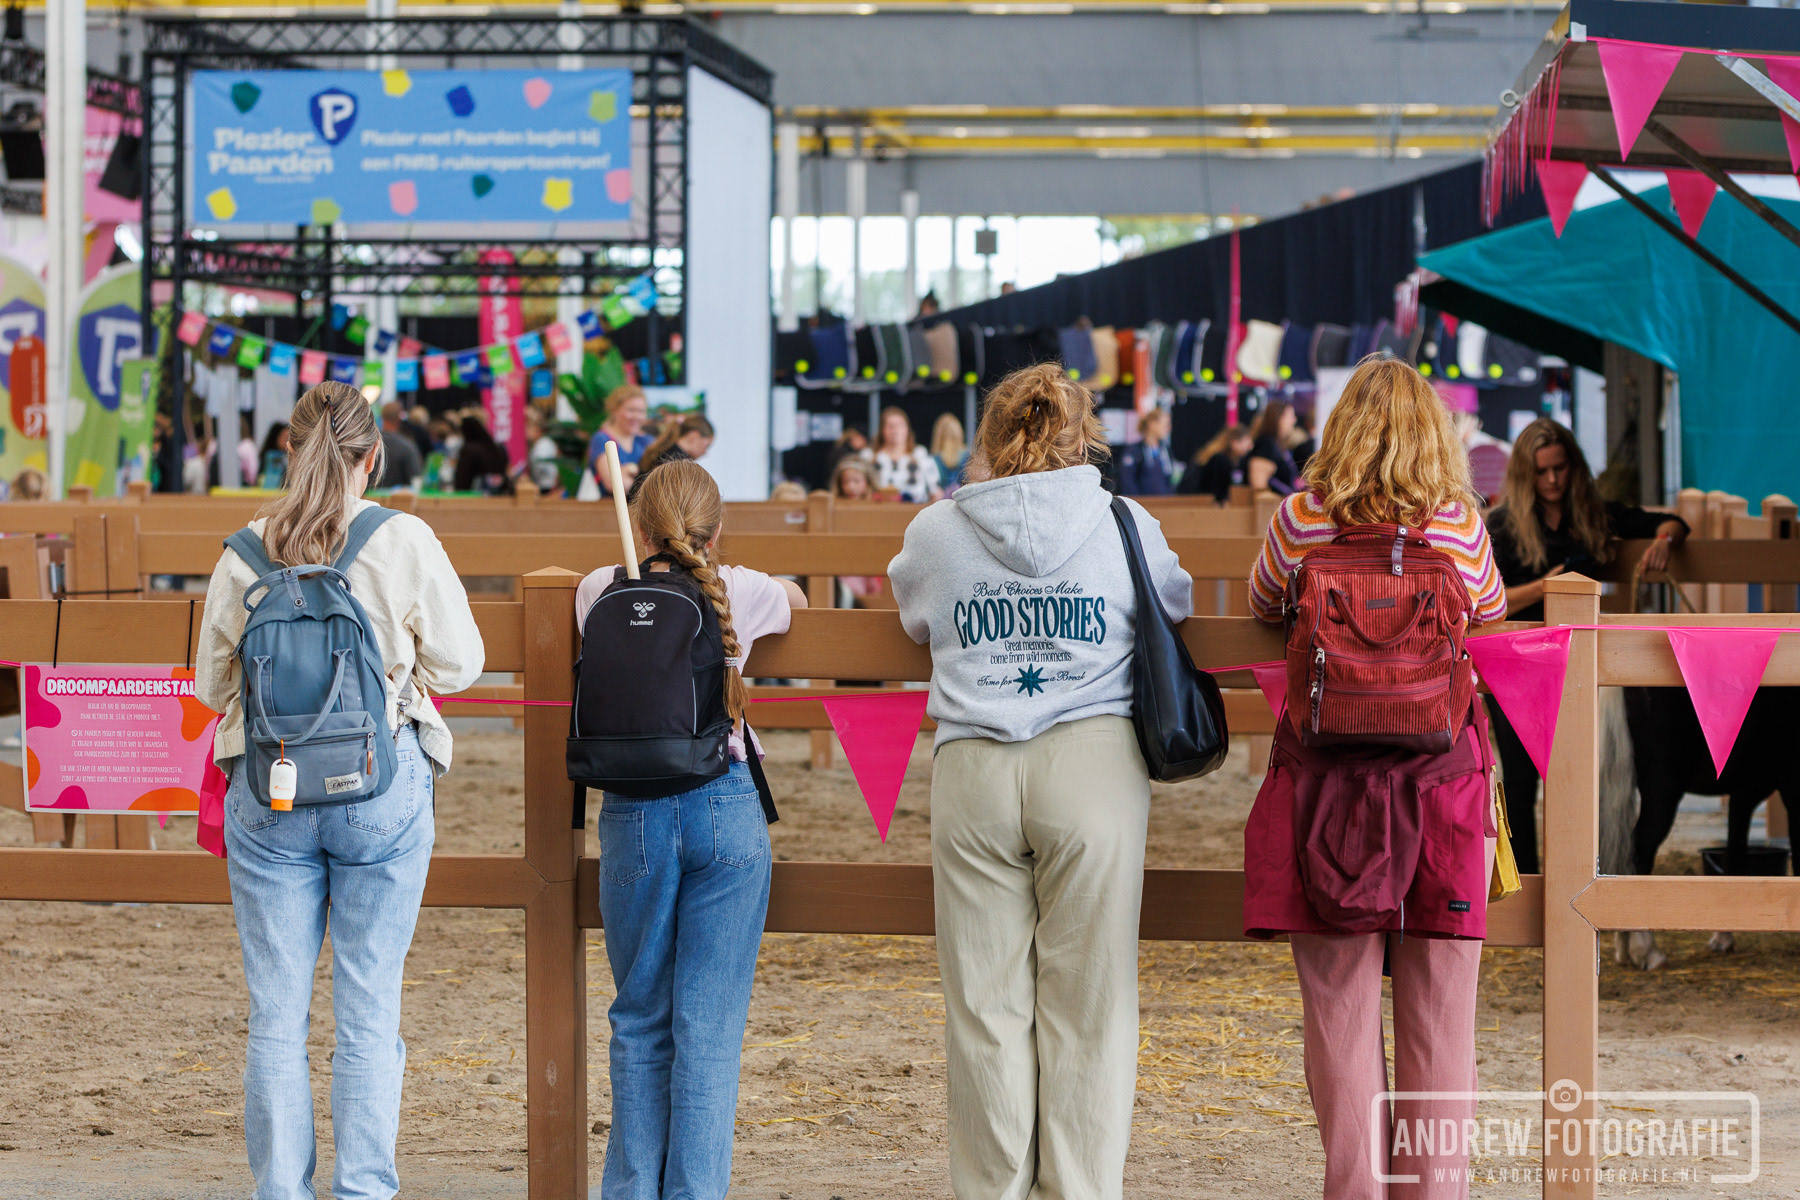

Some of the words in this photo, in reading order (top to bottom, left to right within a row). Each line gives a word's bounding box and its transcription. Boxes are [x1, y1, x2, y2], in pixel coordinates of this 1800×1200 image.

[207, 152, 333, 175] Paarden
[973, 582, 1002, 597] Bad
[1004, 581, 1043, 596] Choices
[1044, 580, 1083, 595] Make
[954, 598, 1014, 649] GOOD
[1017, 596, 1106, 645] STORIES
[1005, 640, 1022, 652] Great
[1023, 639, 1055, 651] memories
[990, 654, 1008, 664] come
[1008, 652, 1025, 664] from
[1026, 651, 1040, 663] wild
[1040, 651, 1072, 663] moments
[46, 679, 195, 696] DROOMPAARDENSTAL
[977, 675, 999, 687] Time
[998, 675, 1012, 690] for
[1056, 670, 1086, 682] Break
[333, 779, 358, 788] EASTPAK
